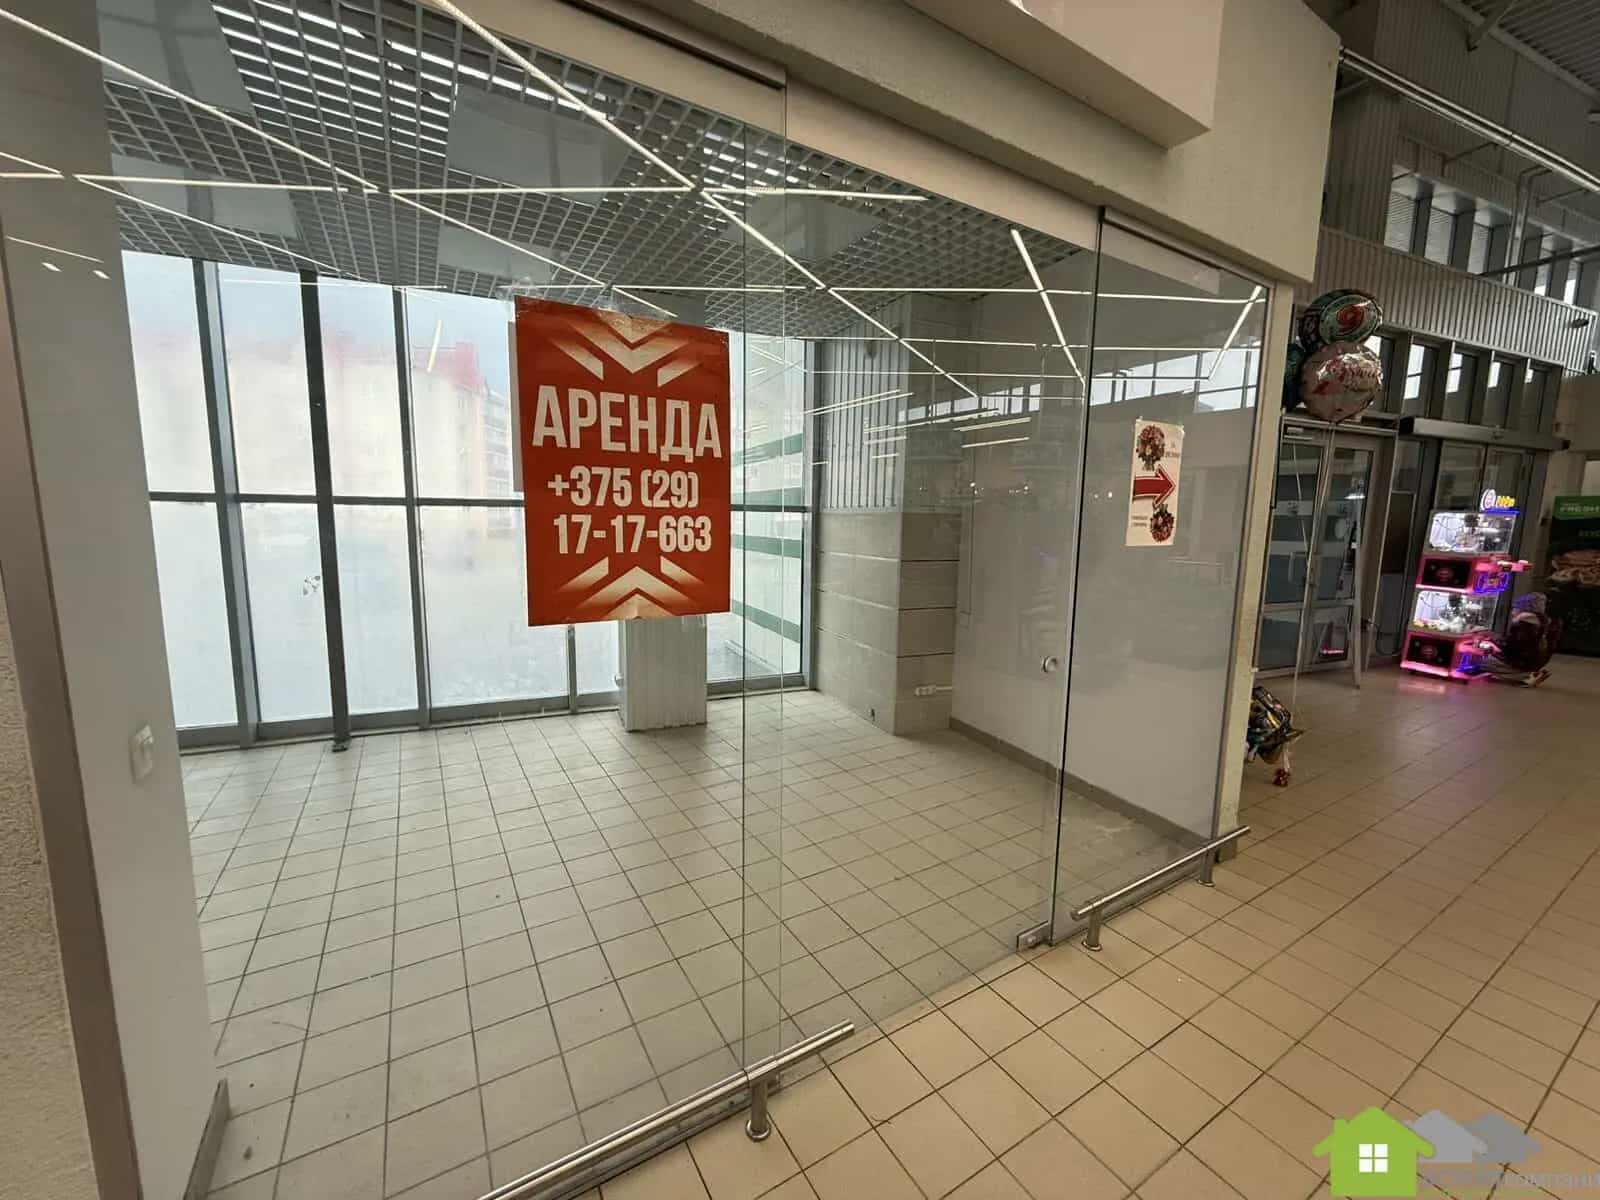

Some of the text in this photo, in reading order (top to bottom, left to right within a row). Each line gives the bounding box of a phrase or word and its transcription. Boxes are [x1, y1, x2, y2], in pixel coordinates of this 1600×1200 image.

[532, 385, 722, 463] АРЕНДА
[548, 465, 699, 508] +375 (29)
[553, 514, 712, 554] 17-17-663
